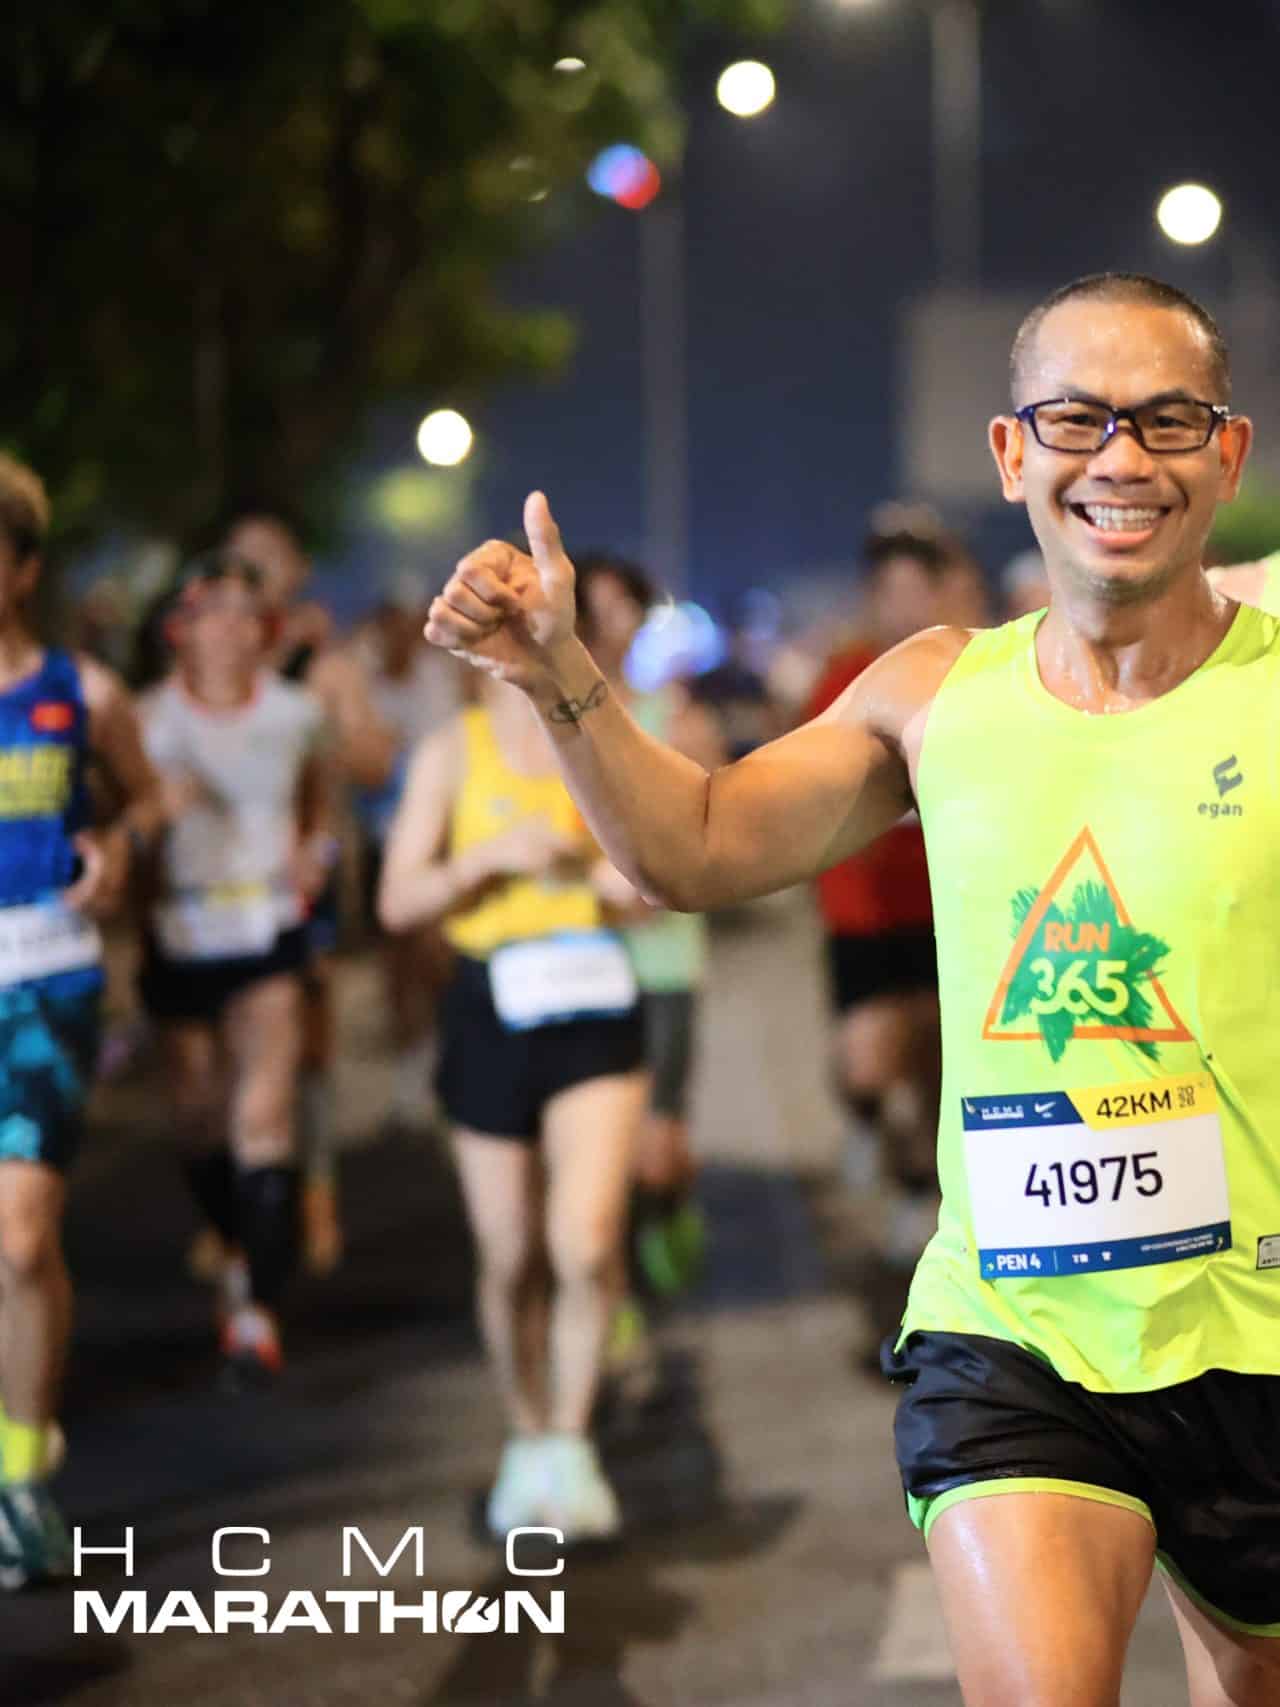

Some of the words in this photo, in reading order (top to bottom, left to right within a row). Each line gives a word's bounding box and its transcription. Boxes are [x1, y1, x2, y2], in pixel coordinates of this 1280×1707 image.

[1197, 802, 1243, 817] egan
[1044, 921, 1110, 952] RUN
[1029, 957, 1130, 1017] 365
[1096, 1088, 1172, 1119] 42KM
[1024, 1151, 1163, 1207] 41975
[996, 1253, 1028, 1271] PEN
[1030, 1253, 1042, 1270] 4
